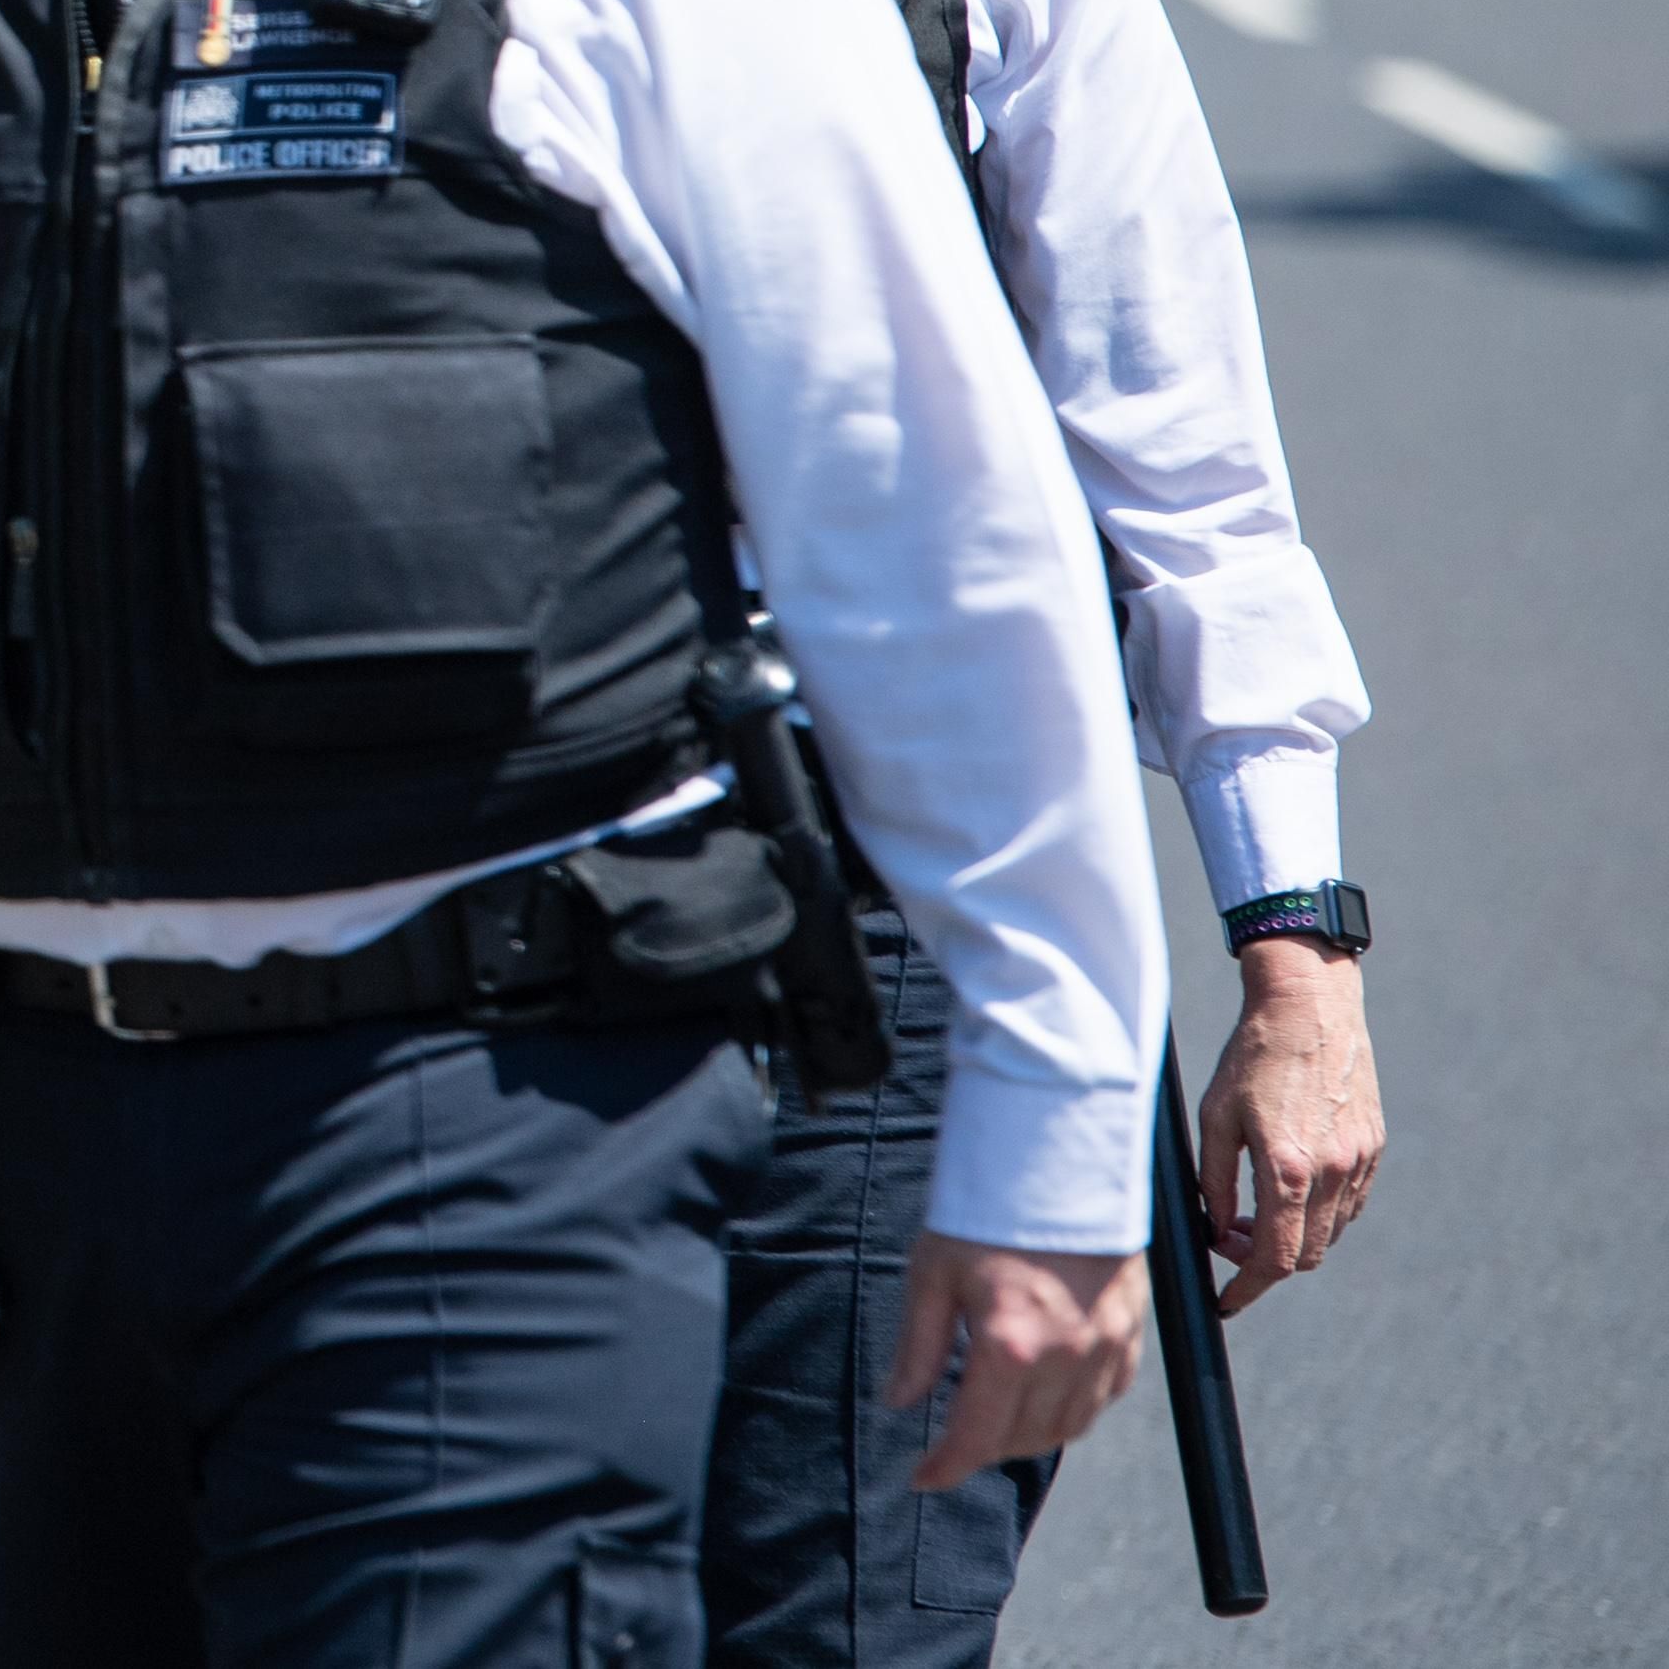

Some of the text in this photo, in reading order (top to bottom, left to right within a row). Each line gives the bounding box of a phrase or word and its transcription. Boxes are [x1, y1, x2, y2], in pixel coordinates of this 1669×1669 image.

[267, 102, 363, 121] POLICE
[167, 138, 393, 176] POLICE OFFICER
